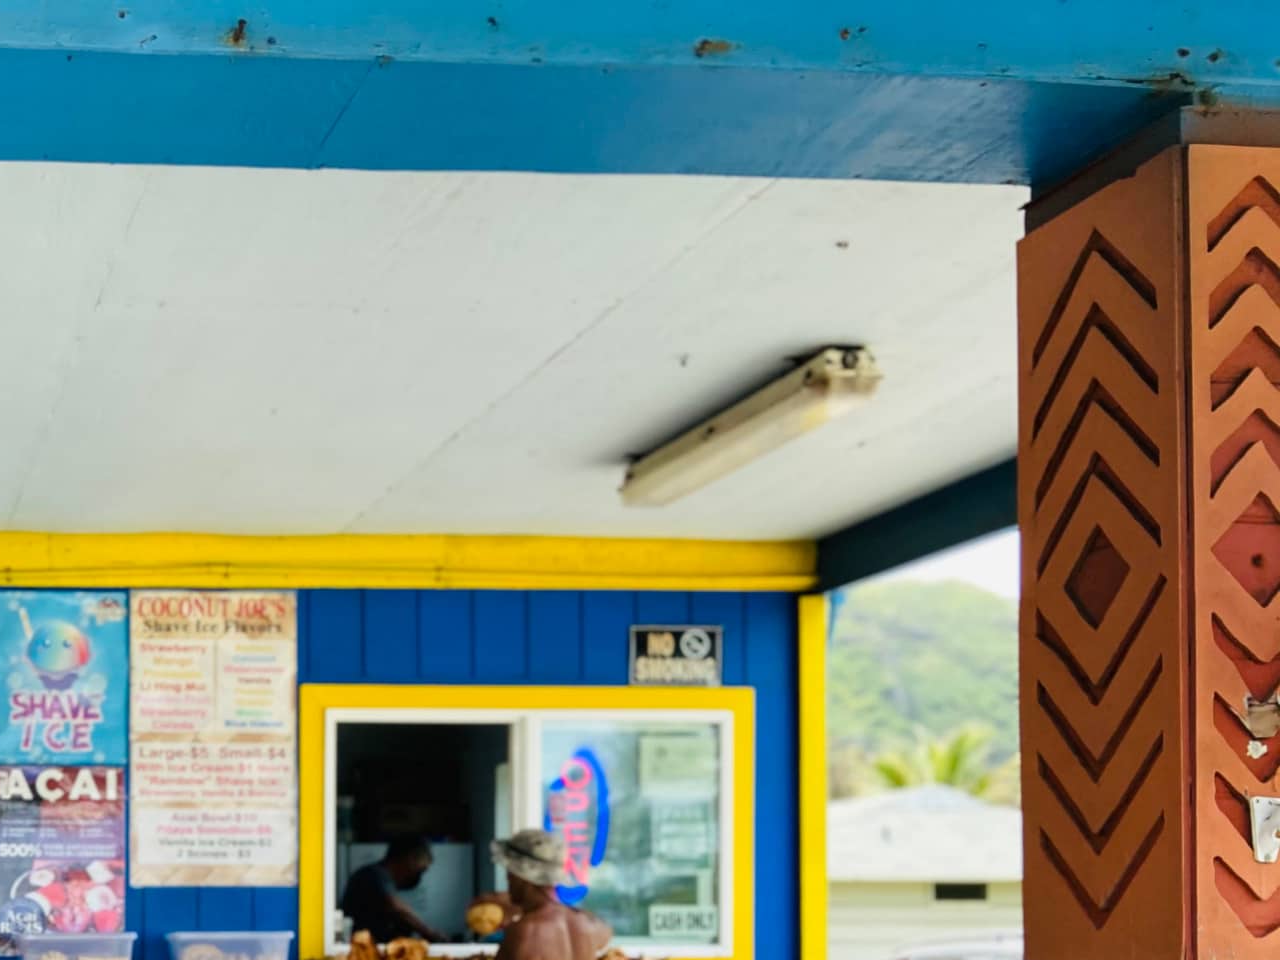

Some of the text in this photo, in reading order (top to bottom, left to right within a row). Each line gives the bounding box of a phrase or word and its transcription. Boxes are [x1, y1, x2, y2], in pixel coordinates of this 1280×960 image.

[137, 595, 230, 618] COCONUT
[143, 619, 283, 633] Shave Ice Flavors
[647, 631, 676, 656] NO
[635, 656, 716, 681] SMOKING
[10, 691, 101, 721] SHAVE
[21, 722, 92, 750] ICE
[0, 842, 43, 858] 500%
[655, 911, 682, 931] CASH
